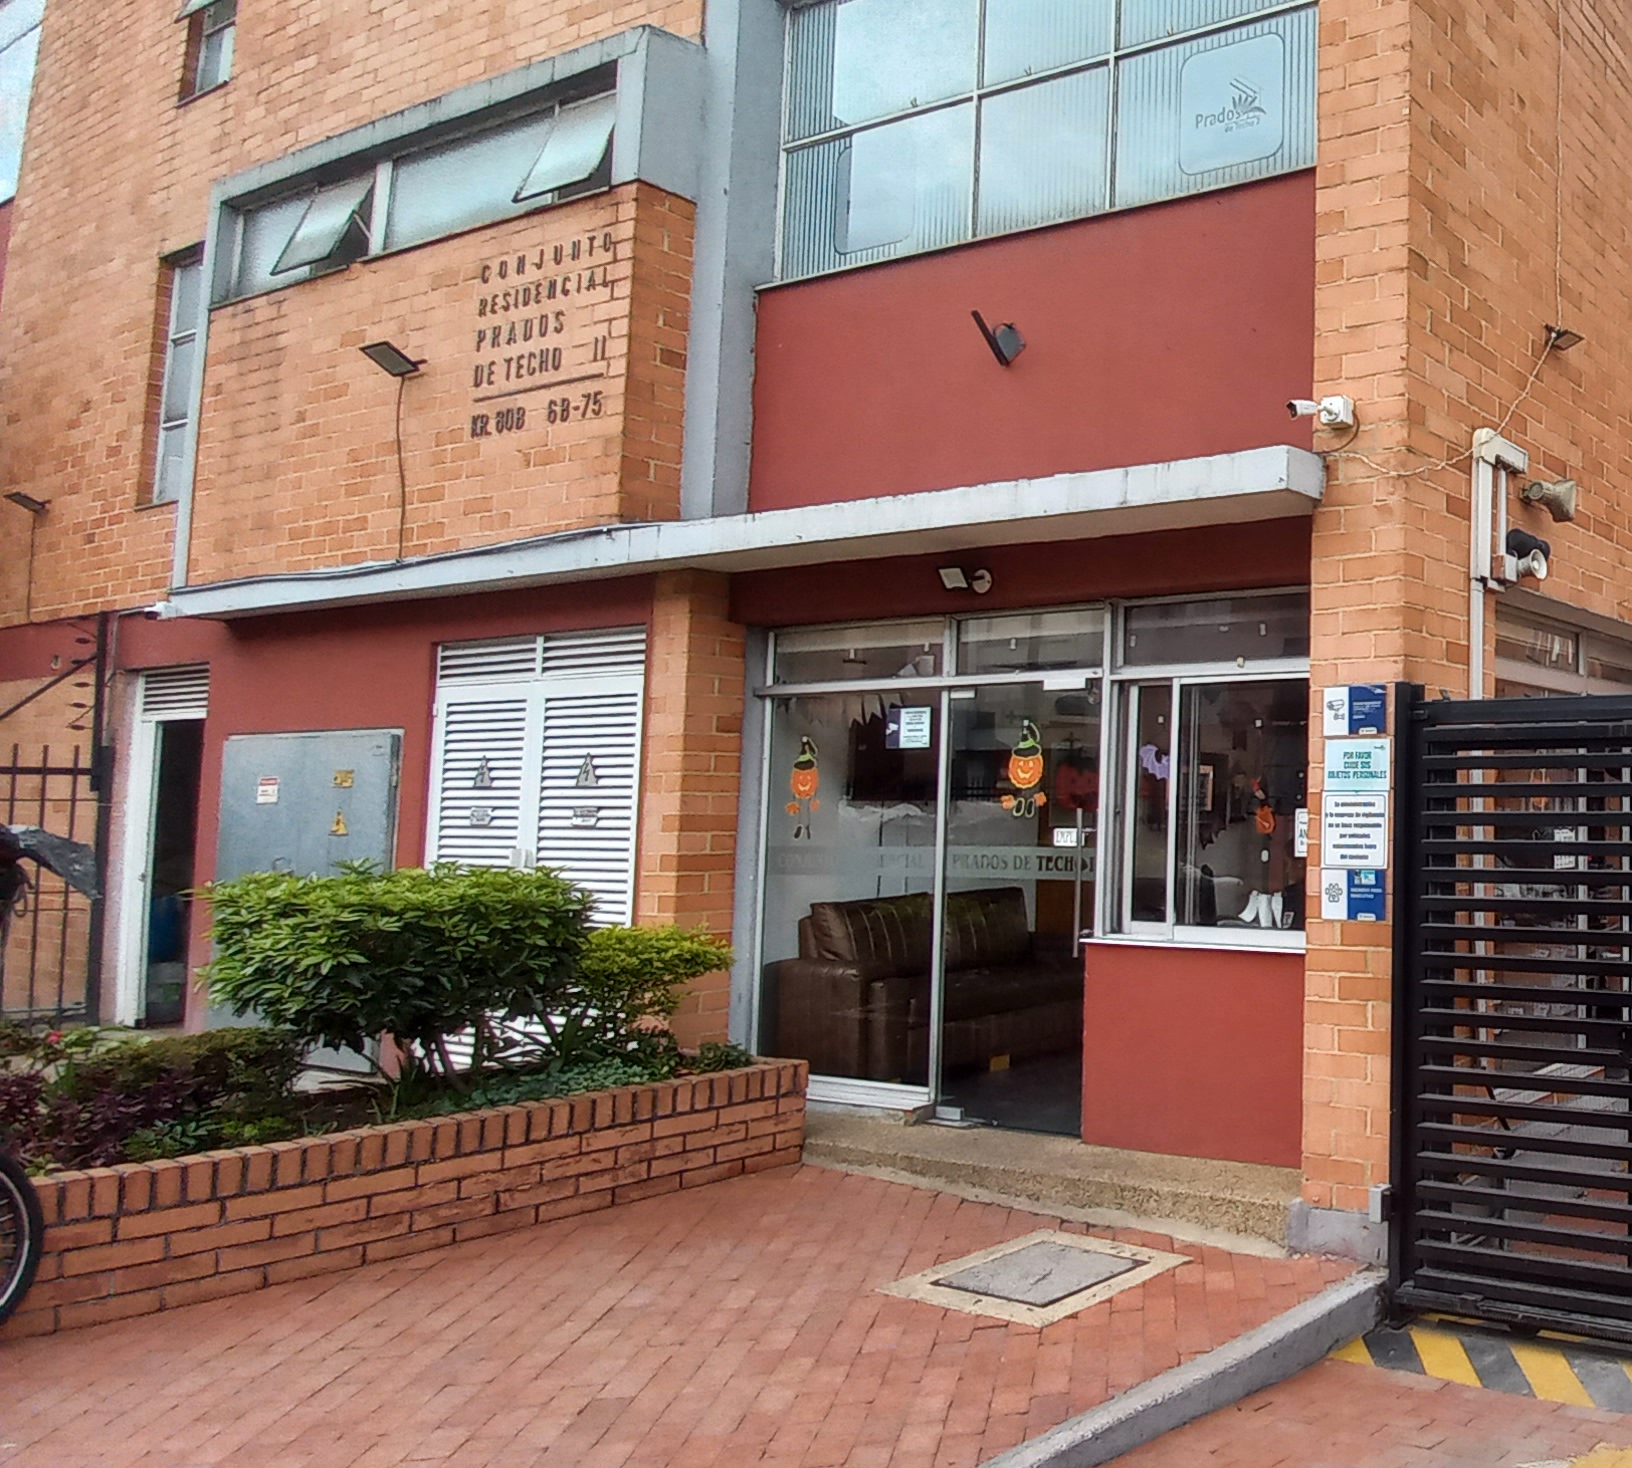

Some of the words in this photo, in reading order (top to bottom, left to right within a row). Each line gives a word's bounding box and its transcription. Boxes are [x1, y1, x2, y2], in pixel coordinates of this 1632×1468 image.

[1195, 106, 1241, 130] Prados
[481, 232, 612, 284] CONJUNTO
[478, 266, 608, 318] RESIDENCIAL
[476, 309, 566, 353] PRADOS
[473, 360, 497, 388] DE
[504, 346, 563, 382] TECHO
[592, 335, 607, 362] II
[547, 390, 604, 424] 6B-75
[952, 854, 1008, 871] PRADOS
[1013, 854, 1031, 871] DE
